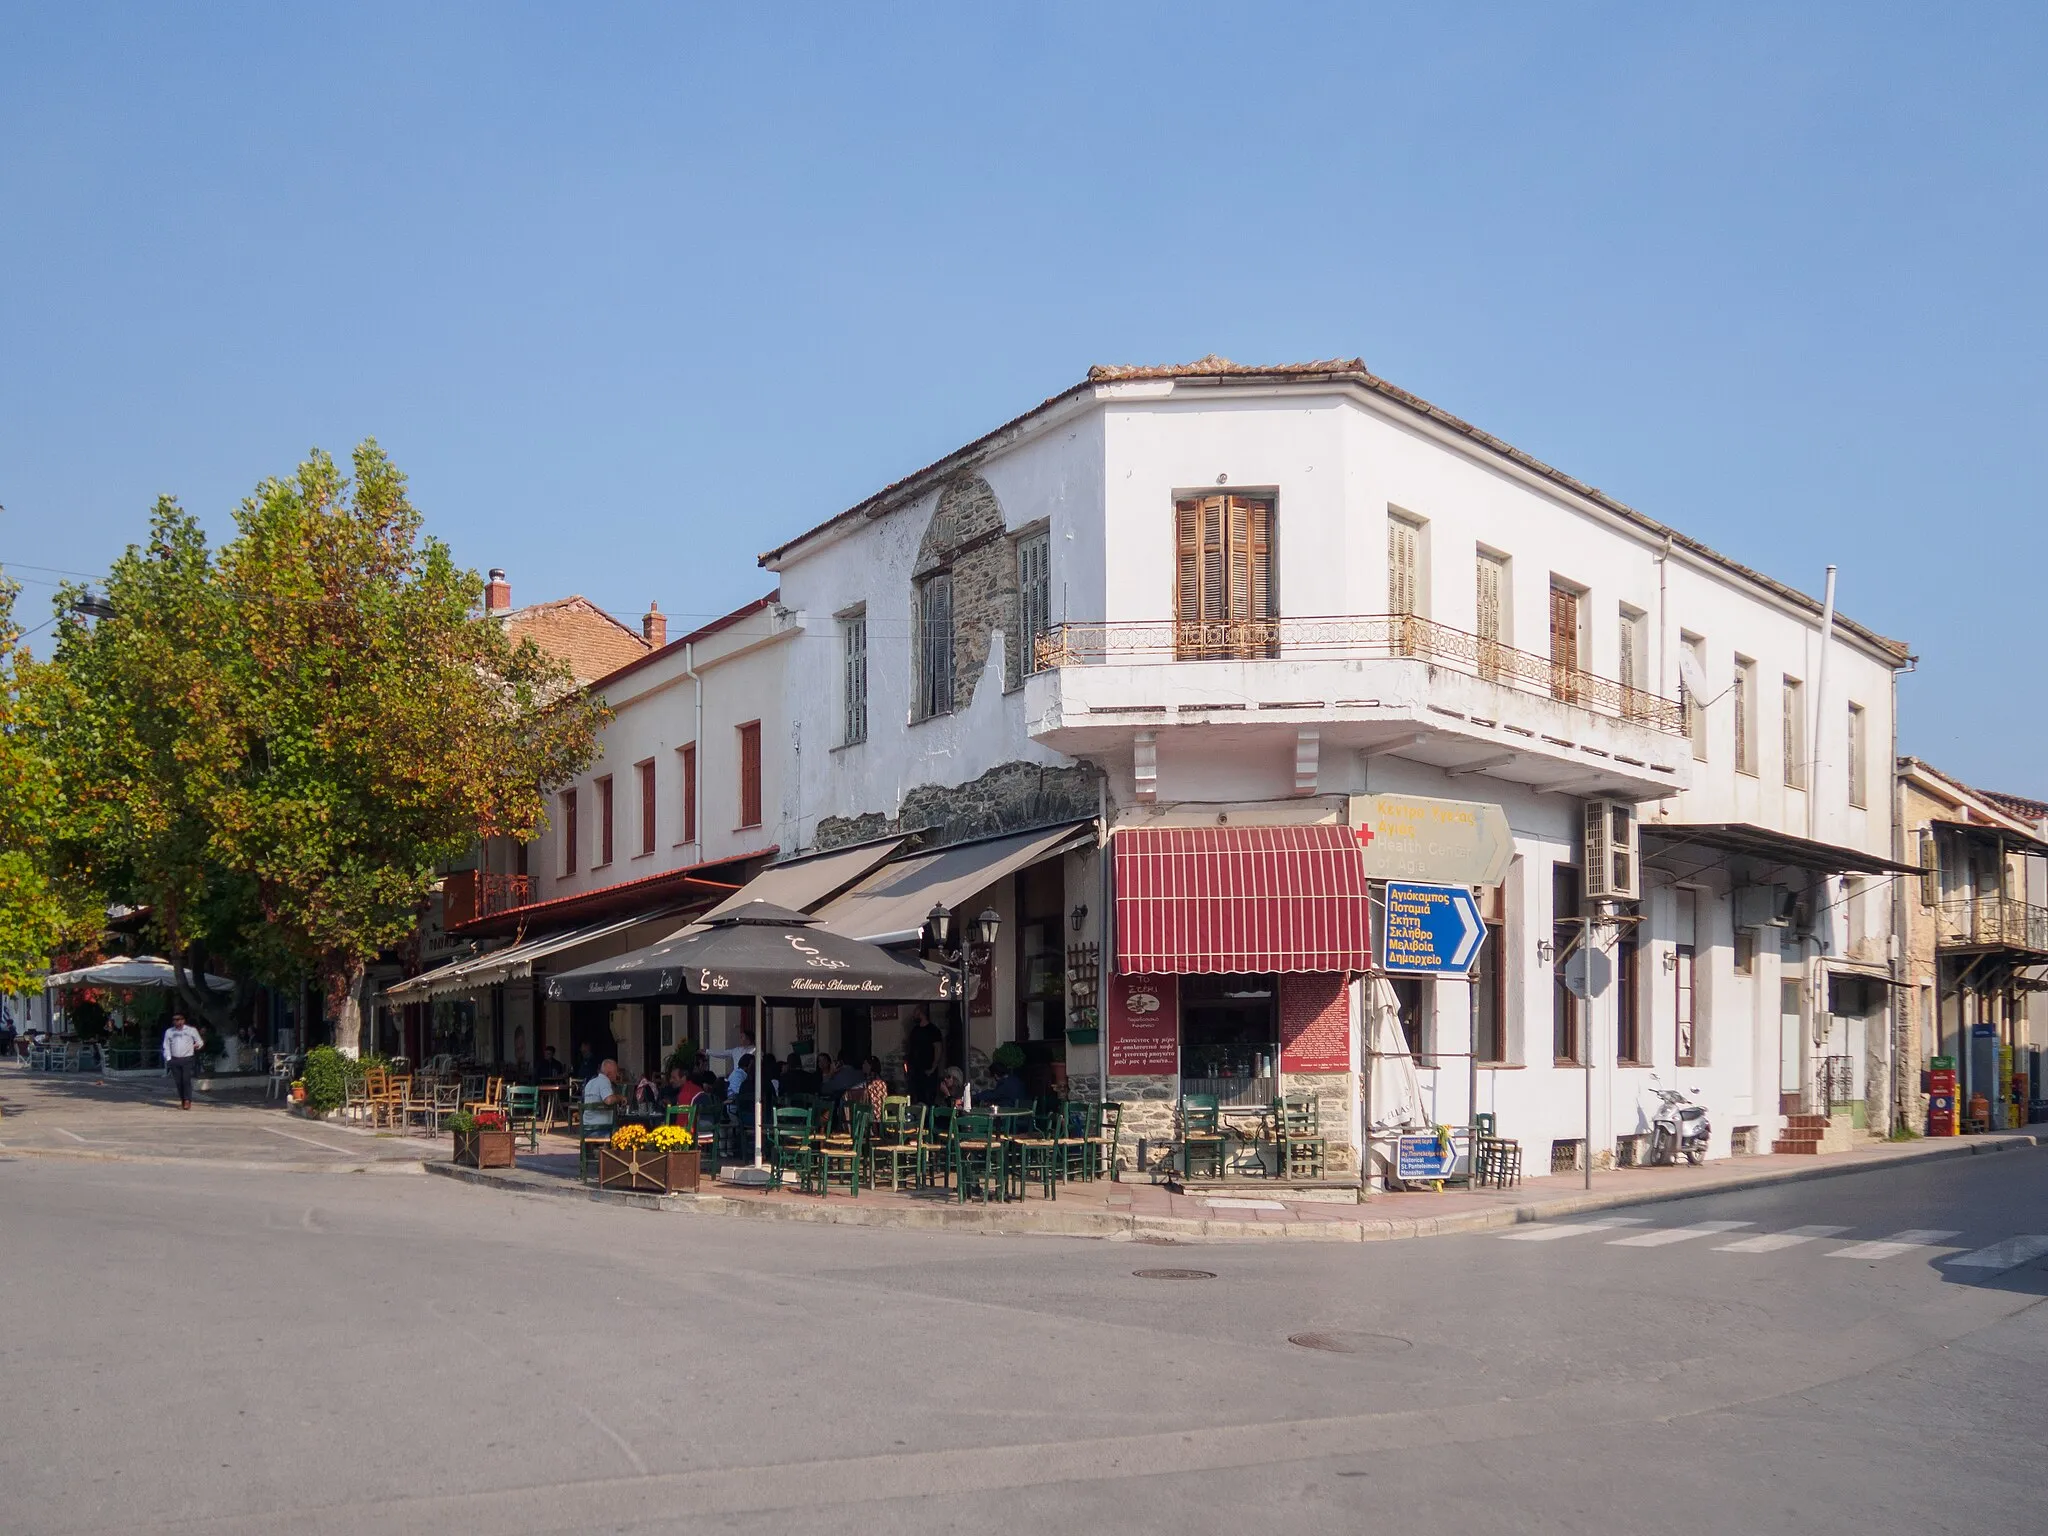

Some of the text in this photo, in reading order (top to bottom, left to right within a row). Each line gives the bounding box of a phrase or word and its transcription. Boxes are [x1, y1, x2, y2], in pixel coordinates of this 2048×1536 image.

[1377, 838, 1422, 854] Health
[1377, 857, 1390, 869] of
[1391, 889, 1450, 905] Αγιόκαμπος
[1390, 901, 1431, 915] Ποταμιά
[1390, 914, 1421, 927] Σκήτη
[1389, 926, 1433, 940] Σκλήθρο
[1389, 939, 1434, 953] Μελιβοία
[1388, 951, 1442, 966] Δημαρχείο
[791, 978, 883, 992] Hellenic Pilsener Beer
